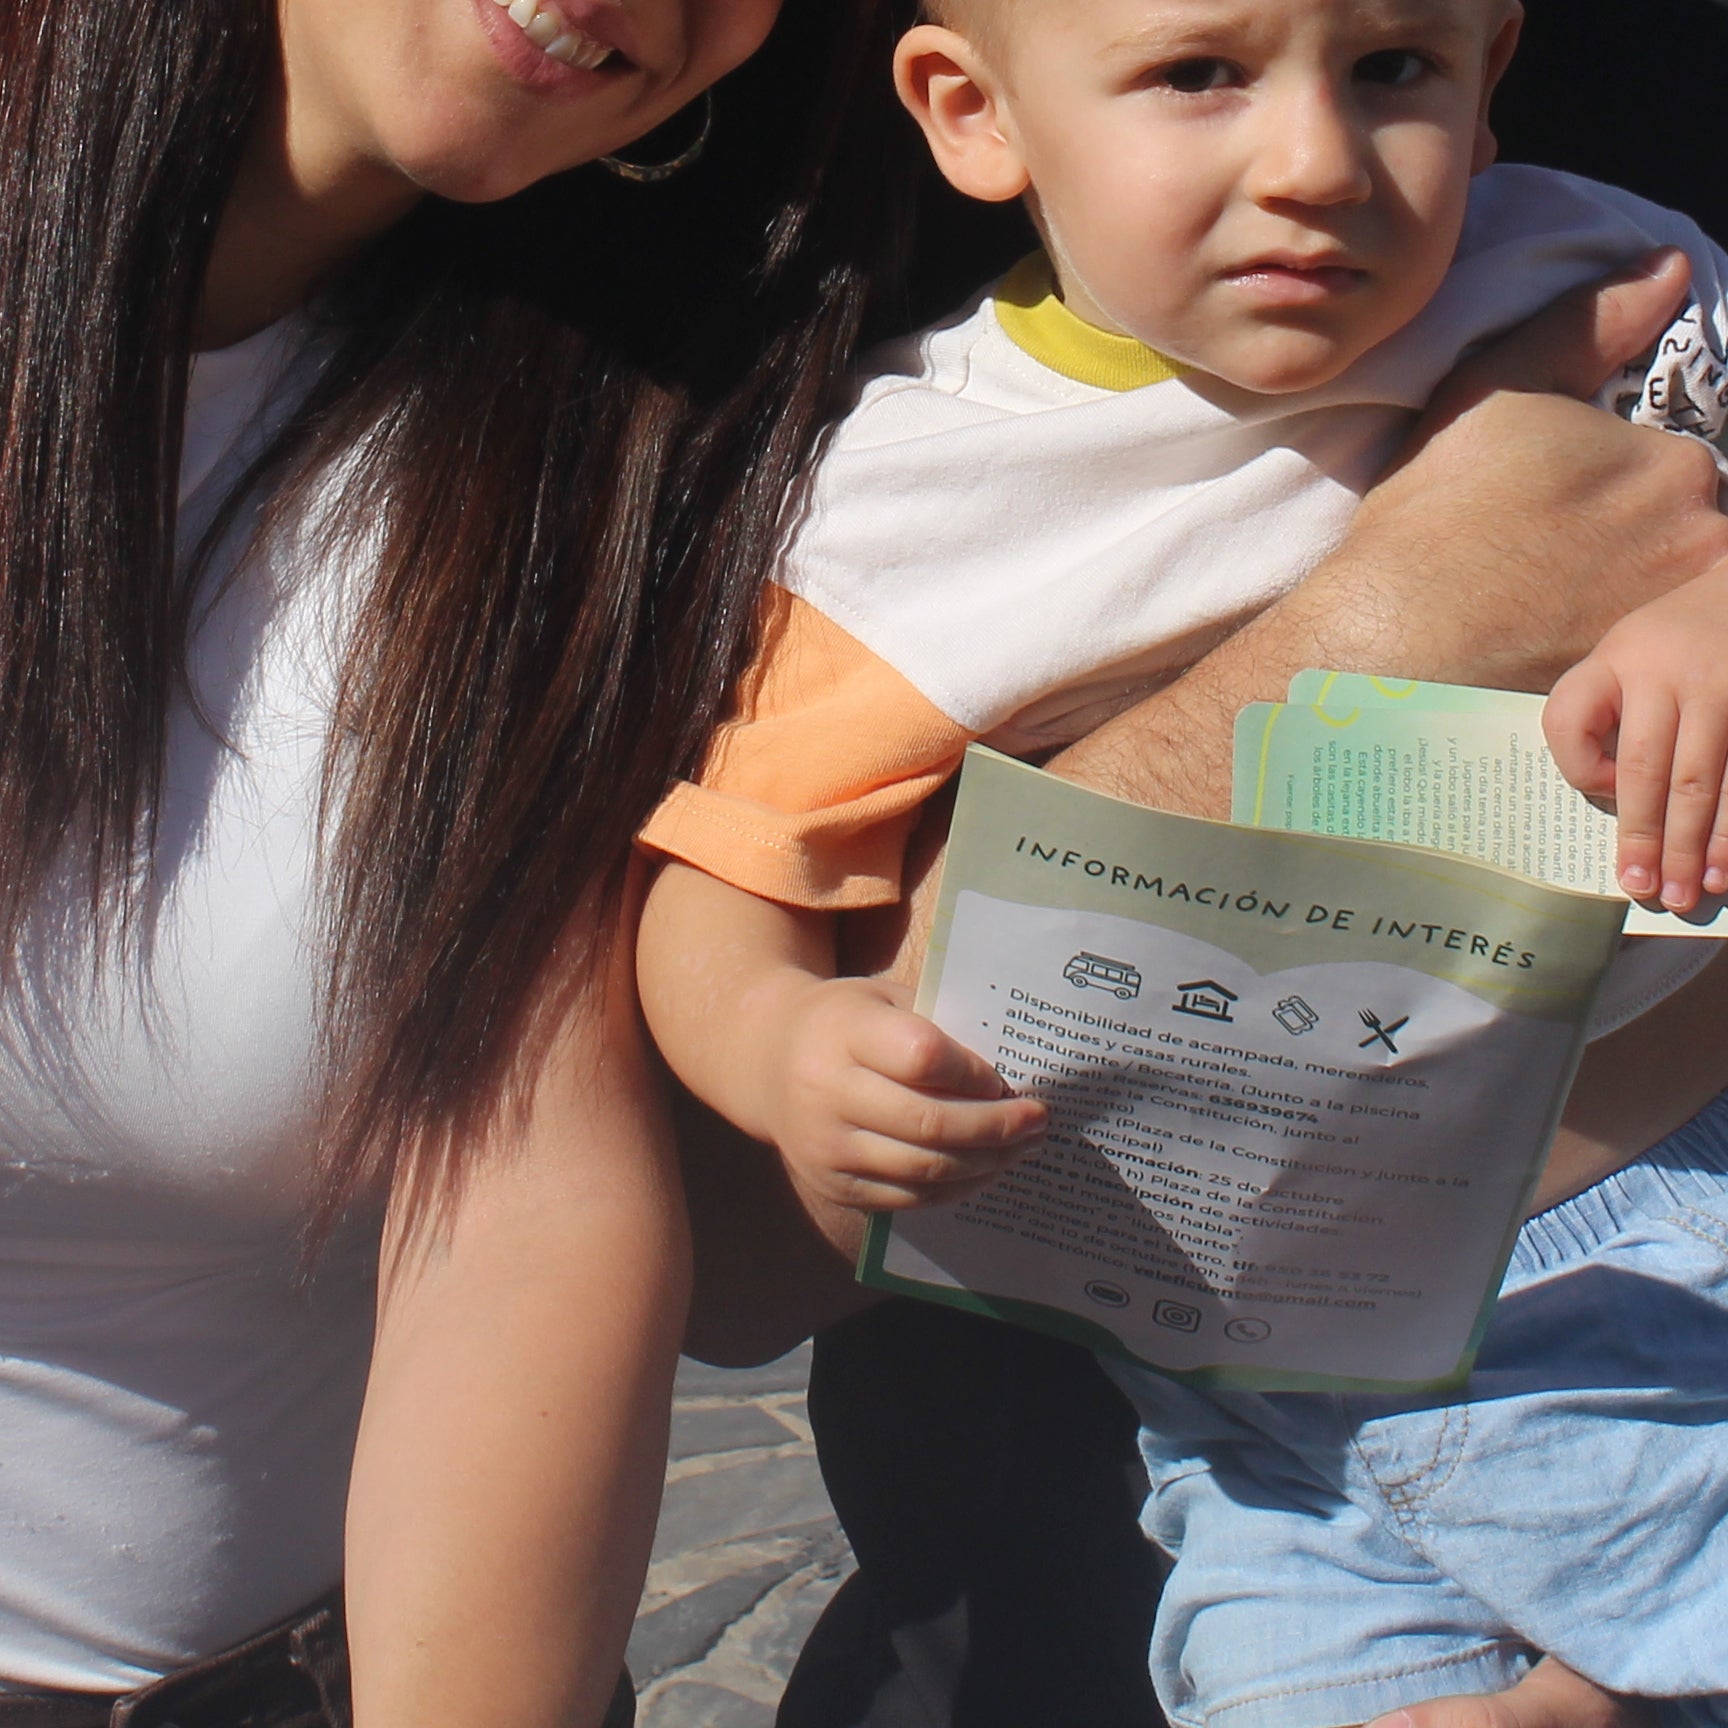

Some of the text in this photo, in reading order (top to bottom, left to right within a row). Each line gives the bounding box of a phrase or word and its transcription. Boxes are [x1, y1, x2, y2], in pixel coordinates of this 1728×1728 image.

[1312, 763, 1322, 810] árboles
[1313, 746, 1323, 765] los
[1326, 740, 1337, 825] son las casitas
[1340, 748, 1353, 816] en la lejana
[1372, 744, 1383, 834] donde abuelita
[1387, 747, 1398, 827] prefiero estar
[1403, 768, 1413, 794] lobo
[1404, 753, 1413, 768] el
[1433, 769, 1444, 781] la
[1446, 736, 1459, 838] y un lobo salió al
[1355, 751, 1368, 830] Está cayendo
[1403, 794, 1413, 806] la
[1416, 779, 1428, 805] Qué
[1431, 782, 1444, 820] quería
[1461, 759, 1472, 842] juguetes para
[1477, 755, 1488, 854] Un día tenía una
[1492, 758, 1503, 841] aquí cerca del
[1507, 731, 1518, 858] cuéntame un cuento
[1523, 751, 1533, 841] antes de irme a
[1538, 745, 1549, 847] Sigue ese cuento
[1417, 805, 1428, 845] miedo
[1552, 783, 1564, 881] fuente de marfil.
[1569, 844, 1578, 861] de
[1582, 825, 1592, 884] de rubíes,
[1596, 840, 1606, 864] que
[1014, 835, 1538, 971] INFORMACIÓN DE INTERÉS
[1598, 864, 1608, 896] tenía
[1004, 1008, 1252, 1078] albergues y casas rurales.
[1009, 987, 1153, 1040] Disponibilidad
[1157, 1030, 1184, 1047] de
[1188, 1039, 1299, 1072] acampada,
[994, 1062, 1025, 1080] Bar
[1031, 1072, 1090, 1094] (Plaza
[1126, 1088, 1144, 1102] la
[1282, 1123, 1336, 1142] junto
[1341, 1134, 1361, 1146] al
[1001, 1024, 1421, 1120] Restaurante Bocatería. (Junto a la piscina
[1077, 1136, 1203, 1179] Información:
[1207, 1170, 1231, 1186] 25
[1236, 1178, 1262, 1194] de
[1115, 1114, 1174, 1139] (Plaza
[1178, 1131, 1204, 1146] de
[1208, 1137, 1226, 1152] la
[1231, 1142, 1357, 1175] Constitución
[1084, 1170, 1194, 1210] inscripción
[1198, 1202, 1224, 1218] de
[1125, 1164, 1145, 1184] h)
[1150, 1171, 1202, 1196] Plaza
[1206, 1187, 1231, 1204] de
[1236, 1195, 1253, 1210] la
